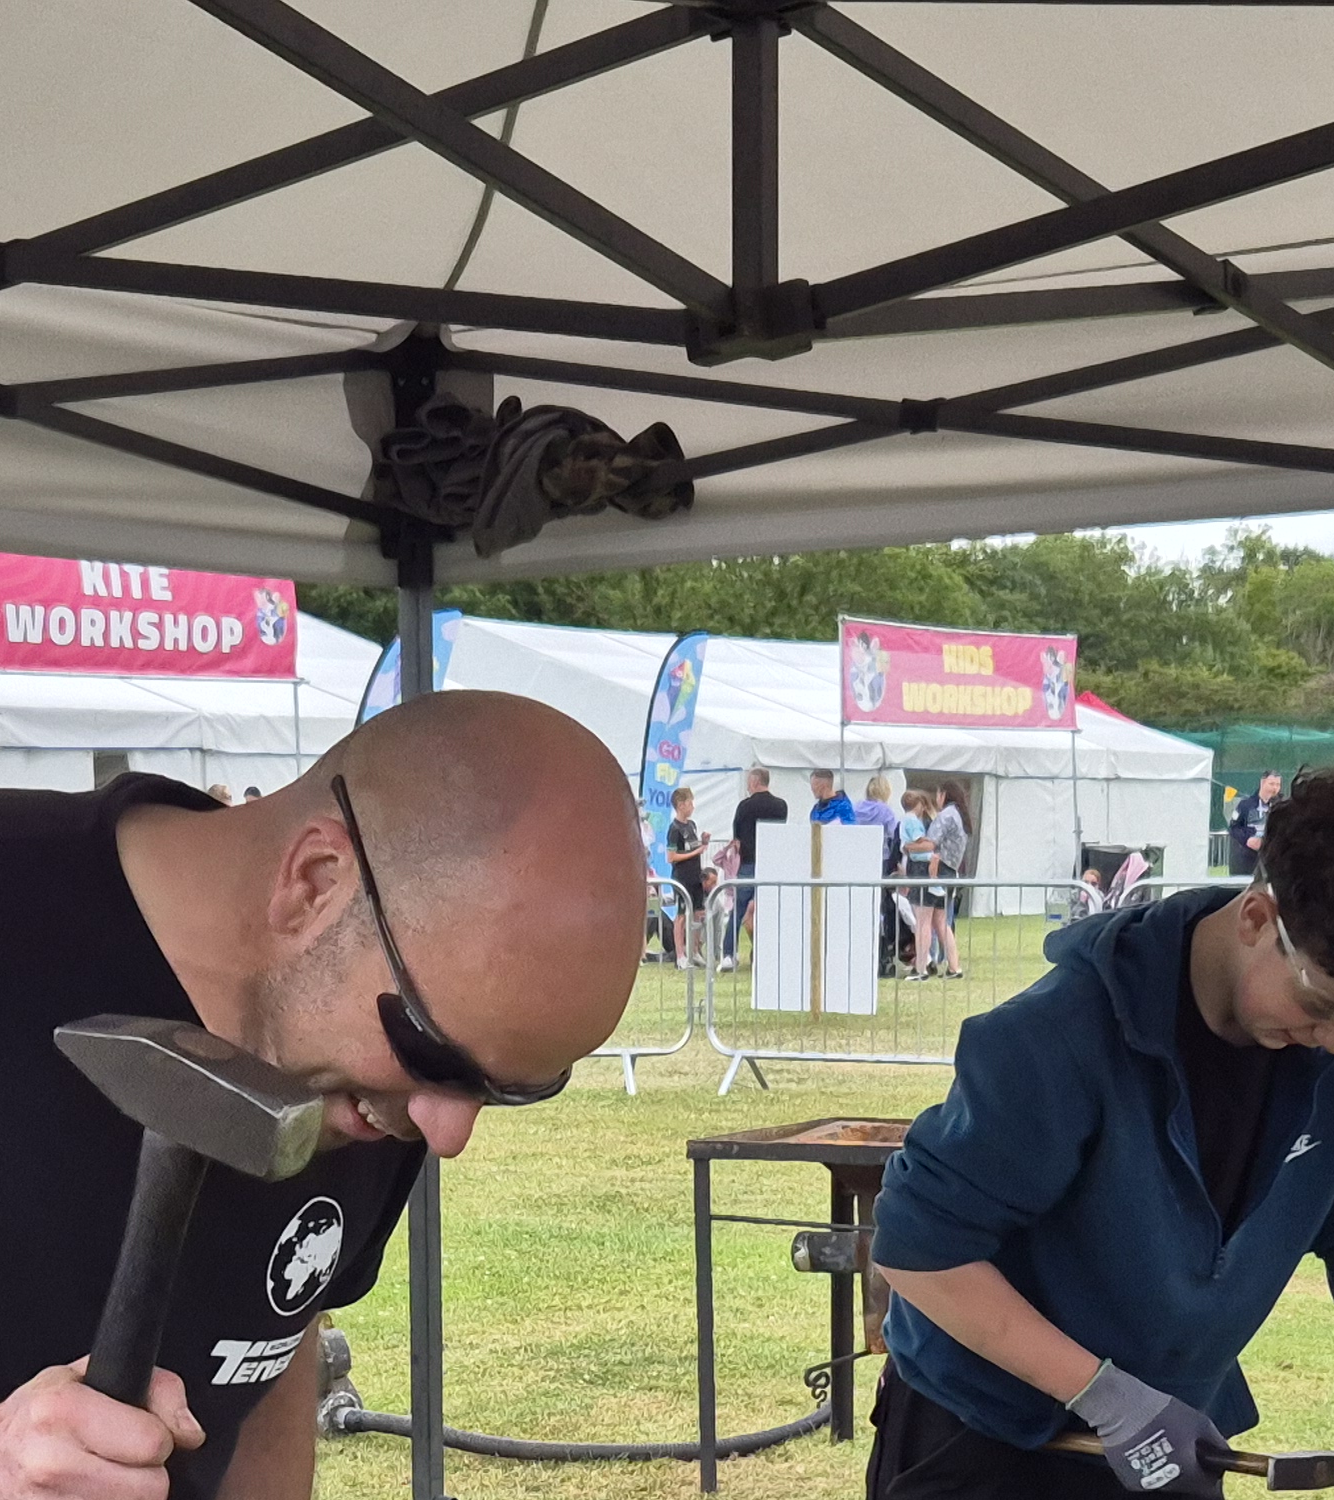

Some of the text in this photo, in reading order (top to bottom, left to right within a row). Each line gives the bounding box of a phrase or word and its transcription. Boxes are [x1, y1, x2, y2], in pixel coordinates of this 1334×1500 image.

[78, 560, 173, 601] KITE
[5, 603, 244, 653] WORKSHOP
[942, 644, 994, 675] KIDS
[902, 682, 1033, 716] WORKSHOP
